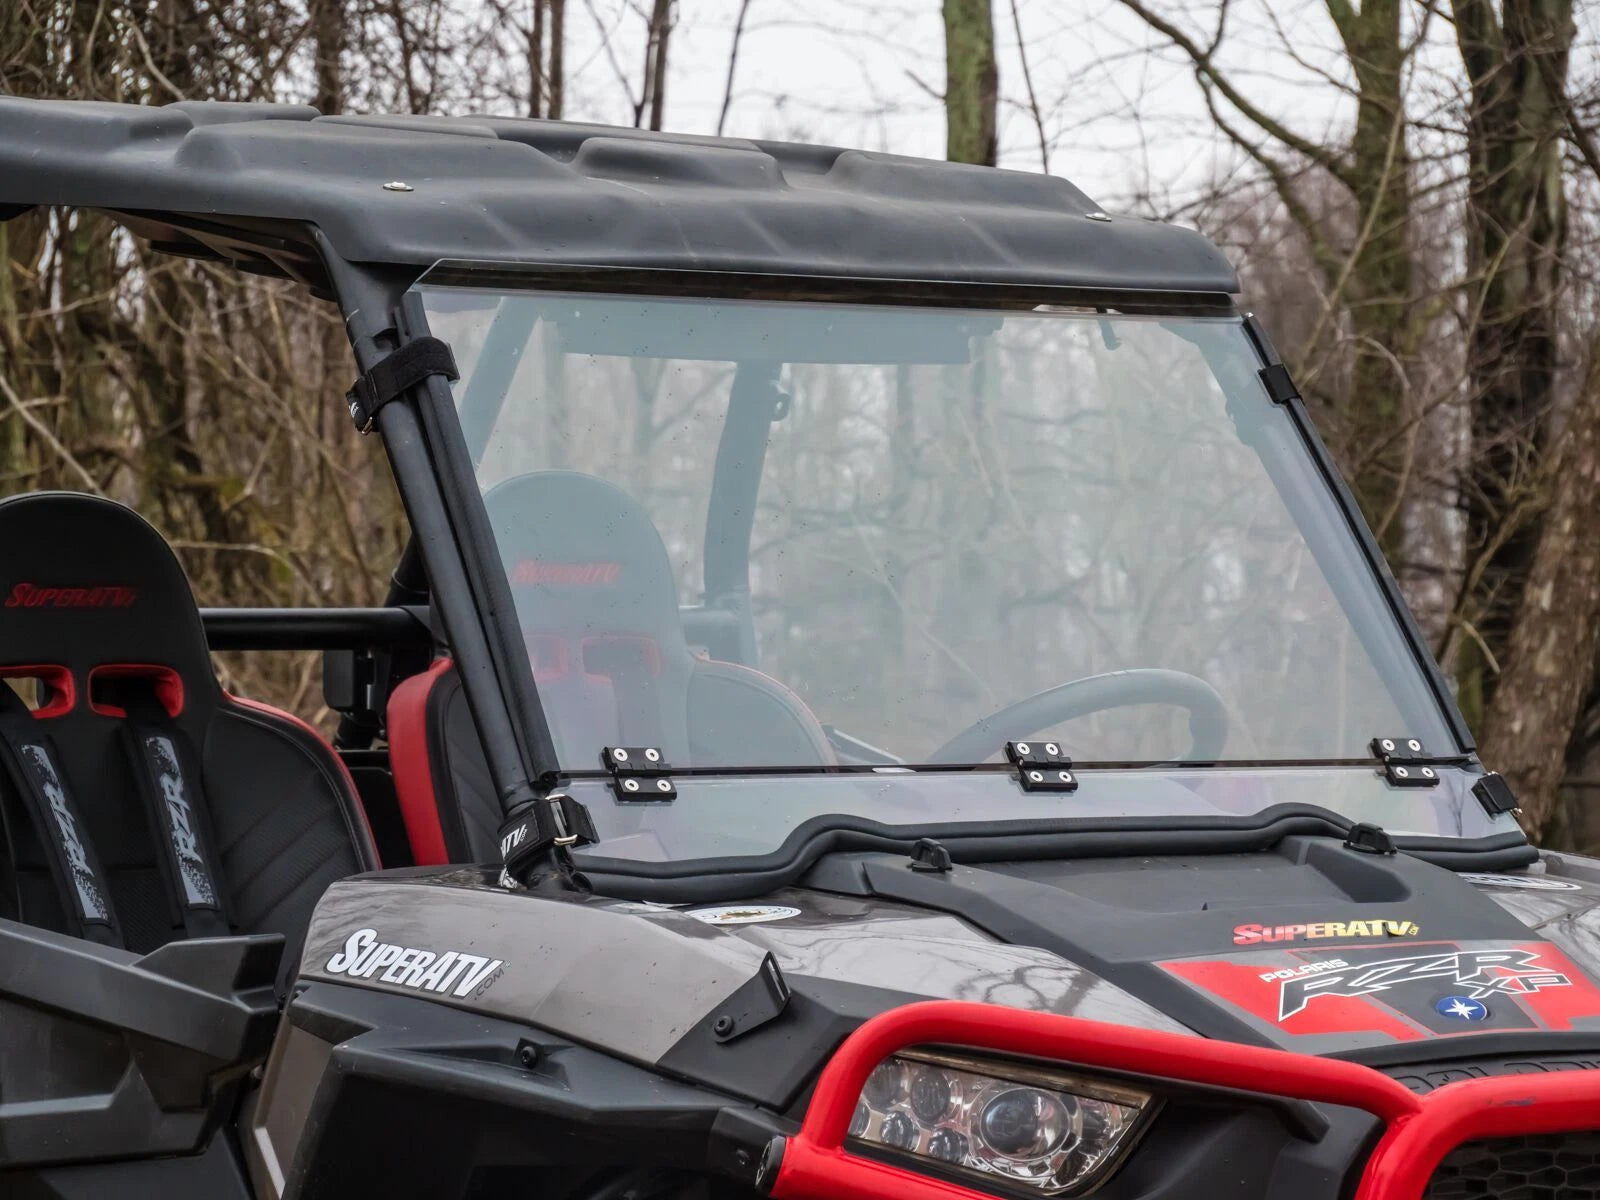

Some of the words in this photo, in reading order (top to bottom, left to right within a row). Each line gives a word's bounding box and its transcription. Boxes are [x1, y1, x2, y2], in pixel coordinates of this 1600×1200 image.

[4, 582, 137, 608] SUPERATV
[43, 781, 94, 877] RZR
[160, 773, 203, 864] RZR
[1233, 919, 1412, 945] SUPERATV
[325, 928, 504, 998] SUPERATV
[1259, 958, 1349, 983] POLARIS
[1278, 949, 1557, 1023] RZR
[1453, 973, 1574, 999] XP
